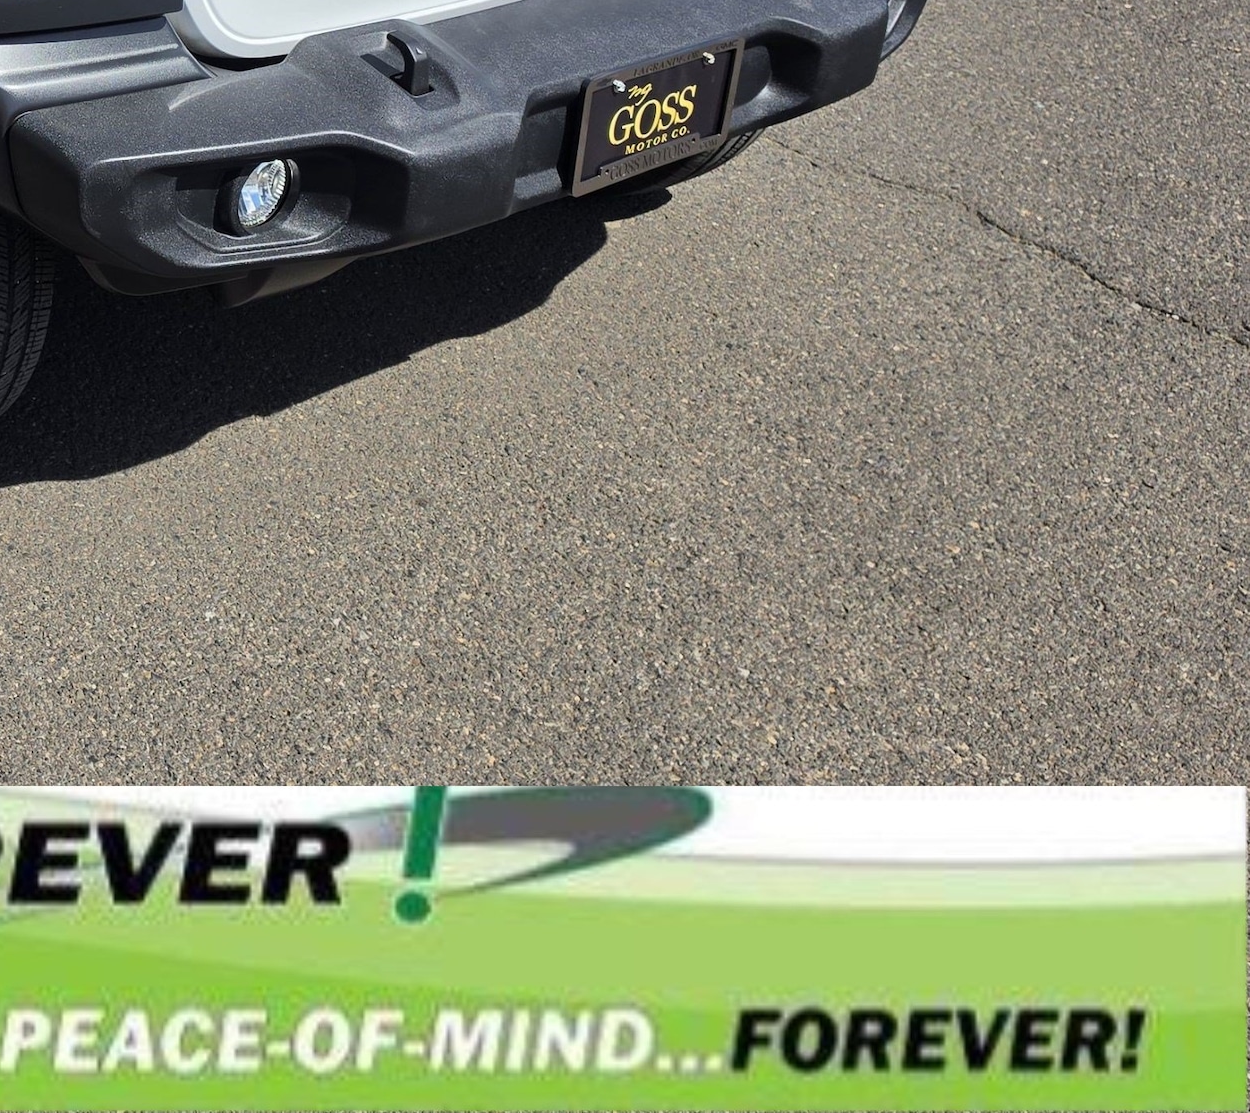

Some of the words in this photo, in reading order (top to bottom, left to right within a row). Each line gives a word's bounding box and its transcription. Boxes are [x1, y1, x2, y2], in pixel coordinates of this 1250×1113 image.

[608, 84, 698, 146] GOSS
[624, 132, 668, 156] MOTOR
[671, 126, 691, 139] CO.
